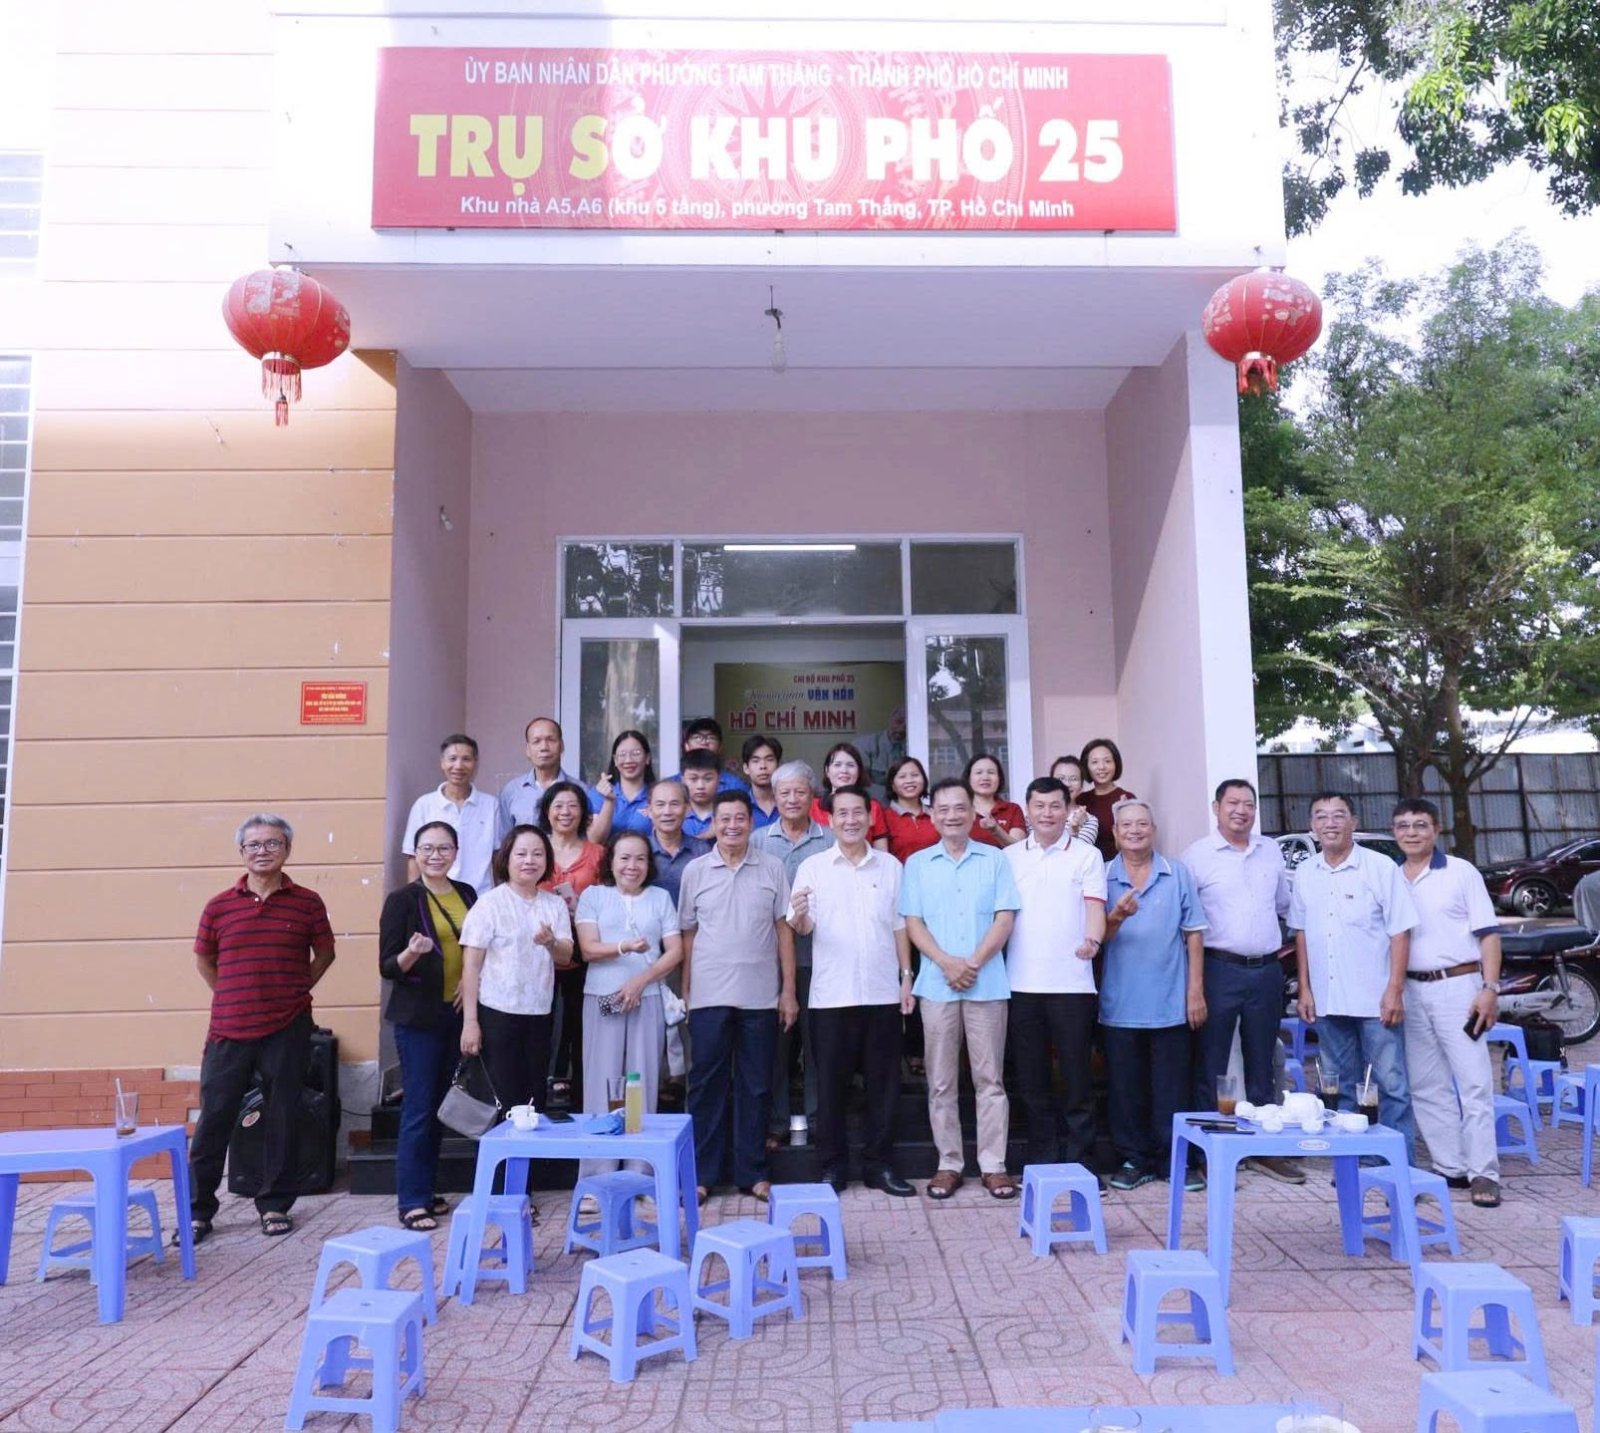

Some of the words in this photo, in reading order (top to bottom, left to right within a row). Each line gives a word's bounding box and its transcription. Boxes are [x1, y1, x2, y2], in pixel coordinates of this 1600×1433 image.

[465, 57, 490, 84] ỦY
[495, 61, 533, 84] BAN
[539, 57, 590, 84] NHÂN
[596, 57, 635, 85] DÂN
[727, 63, 763, 86] TAM
[847, 60, 910, 88] THÀNH
[957, 61, 984, 88] HỒ
[988, 61, 1019, 88] CHÍ
[1023, 66, 1068, 89] MINH
[410, 114, 543, 196] TRỤ
[569, 95, 667, 181] SỞ
[690, 115, 837, 182] KHU
[866, 97, 1015, 183] PHỐ
[1038, 119, 1124, 183] 25
[461, 197, 499, 214] Khu
[506, 197, 540, 214] nhà
[546, 198, 602, 217] A5,A6
[607, 198, 651, 218] (khu
[814, 198, 852, 216] Tam
[927, 198, 955, 216] TP.
[961, 195, 987, 216] Hồ
[993, 197, 1024, 216] Chí
[1029, 199, 1074, 217] Minh
[730, 703, 757, 729] HỒ
[765, 706, 796, 729] CHÍ
[804, 710, 856, 729] MINH
